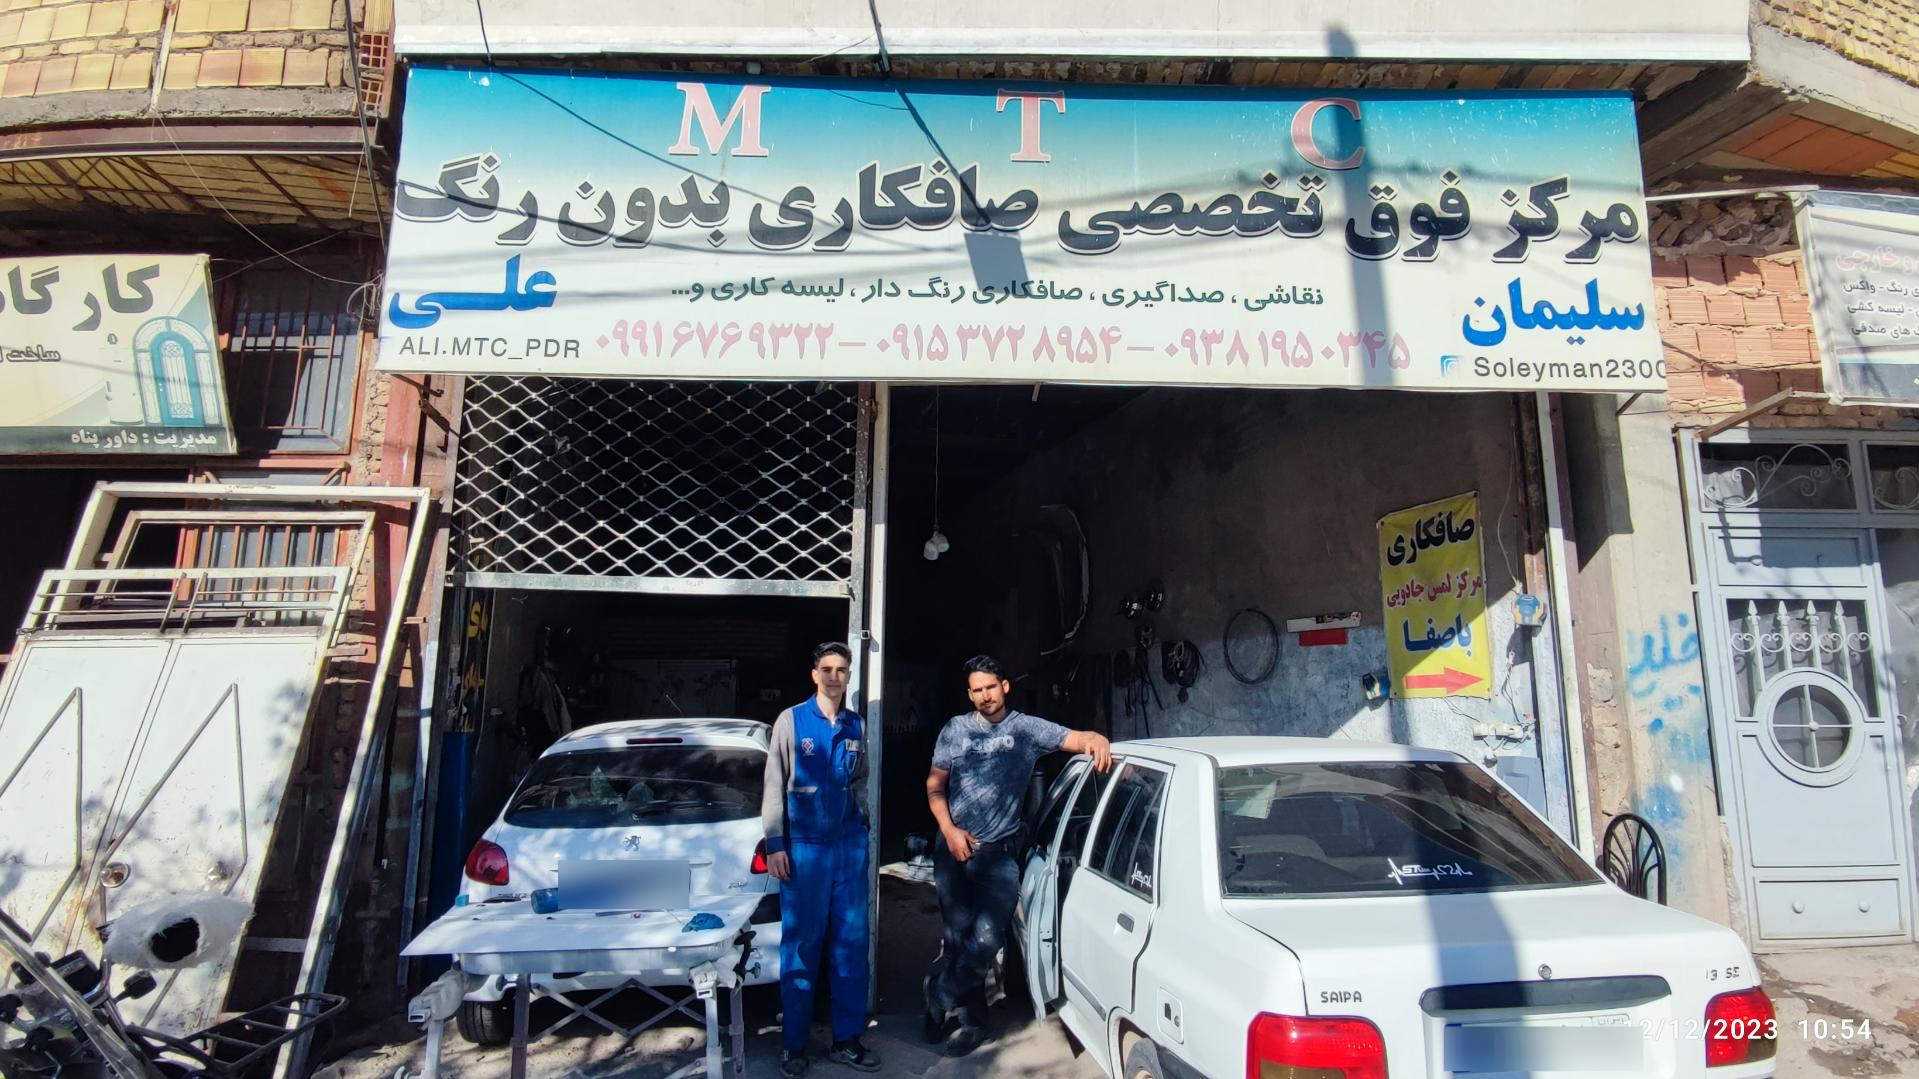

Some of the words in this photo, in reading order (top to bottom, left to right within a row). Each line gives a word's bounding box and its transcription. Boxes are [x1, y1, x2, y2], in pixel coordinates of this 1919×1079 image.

[669, 82, 772, 157] M
[996, 89, 1066, 163] T
[1290, 97, 1365, 170] C
[395, 152, 539, 245] رنگ
[556, 173, 731, 248] بدون
[748, 158, 1040, 251] صافکاری
[1058, 170, 1326, 255] تخصصی
[1345, 169, 1472, 262] فوق
[1491, 175, 1642, 264] مرکز
[389, 253, 558, 329] علی
[711, 277, 775, 301] کاری
[781, 278, 844, 303] لیسه
[972, 280, 1083, 304] صافکاری
[1102, 281, 1225, 308] صداگیری
[1244, 285, 1324, 311] نقاشی
[1462, 276, 1645, 346] سلیمان
[399, 336, 580, 359] ALI.MTC_PDR
[153, 432, 217, 448] مدیریت
[1387, 511, 1476, 566] صافکاری
[1427, 572, 1452, 602] لمس
[1456, 569, 1483, 600] مرکز
[1320, 990, 1362, 1003] SAIPA
